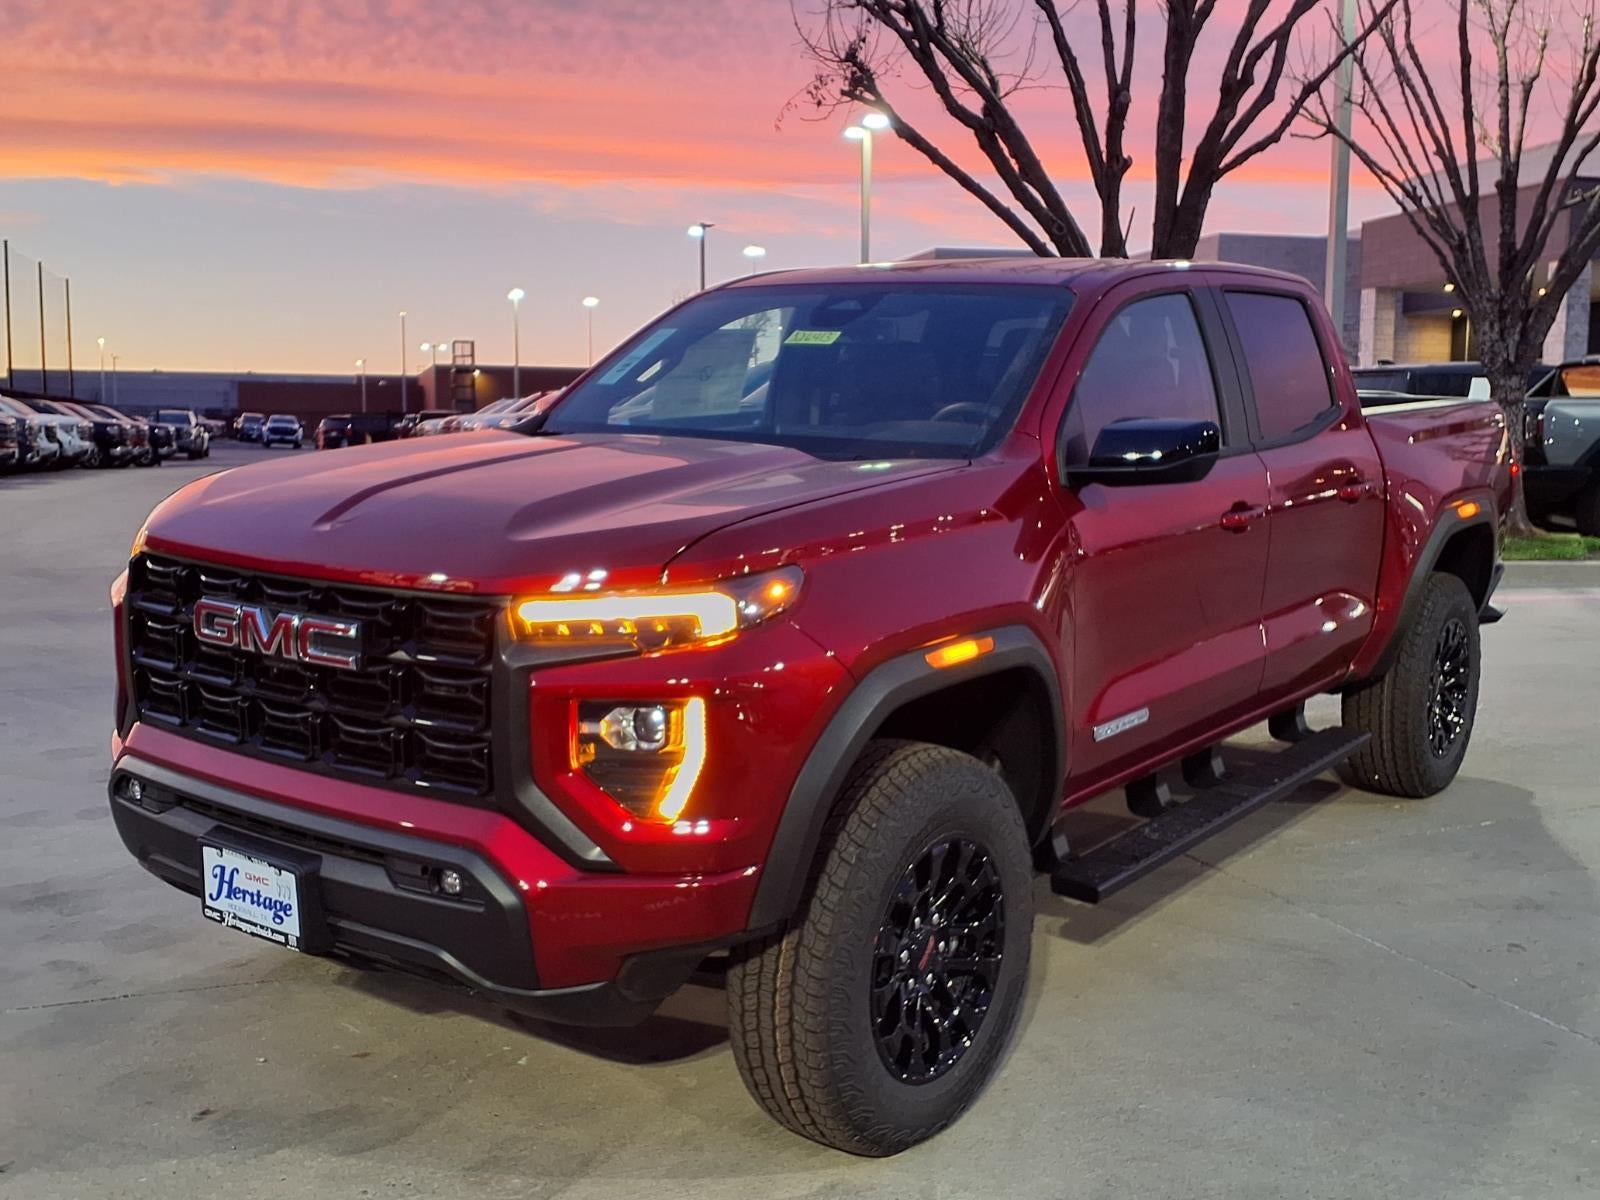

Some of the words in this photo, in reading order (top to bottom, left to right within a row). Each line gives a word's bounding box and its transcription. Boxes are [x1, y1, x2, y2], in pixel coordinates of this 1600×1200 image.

[193, 596, 359, 671] GMC
[209, 865, 292, 925] Heritage
[245, 872, 270, 886] GMC
